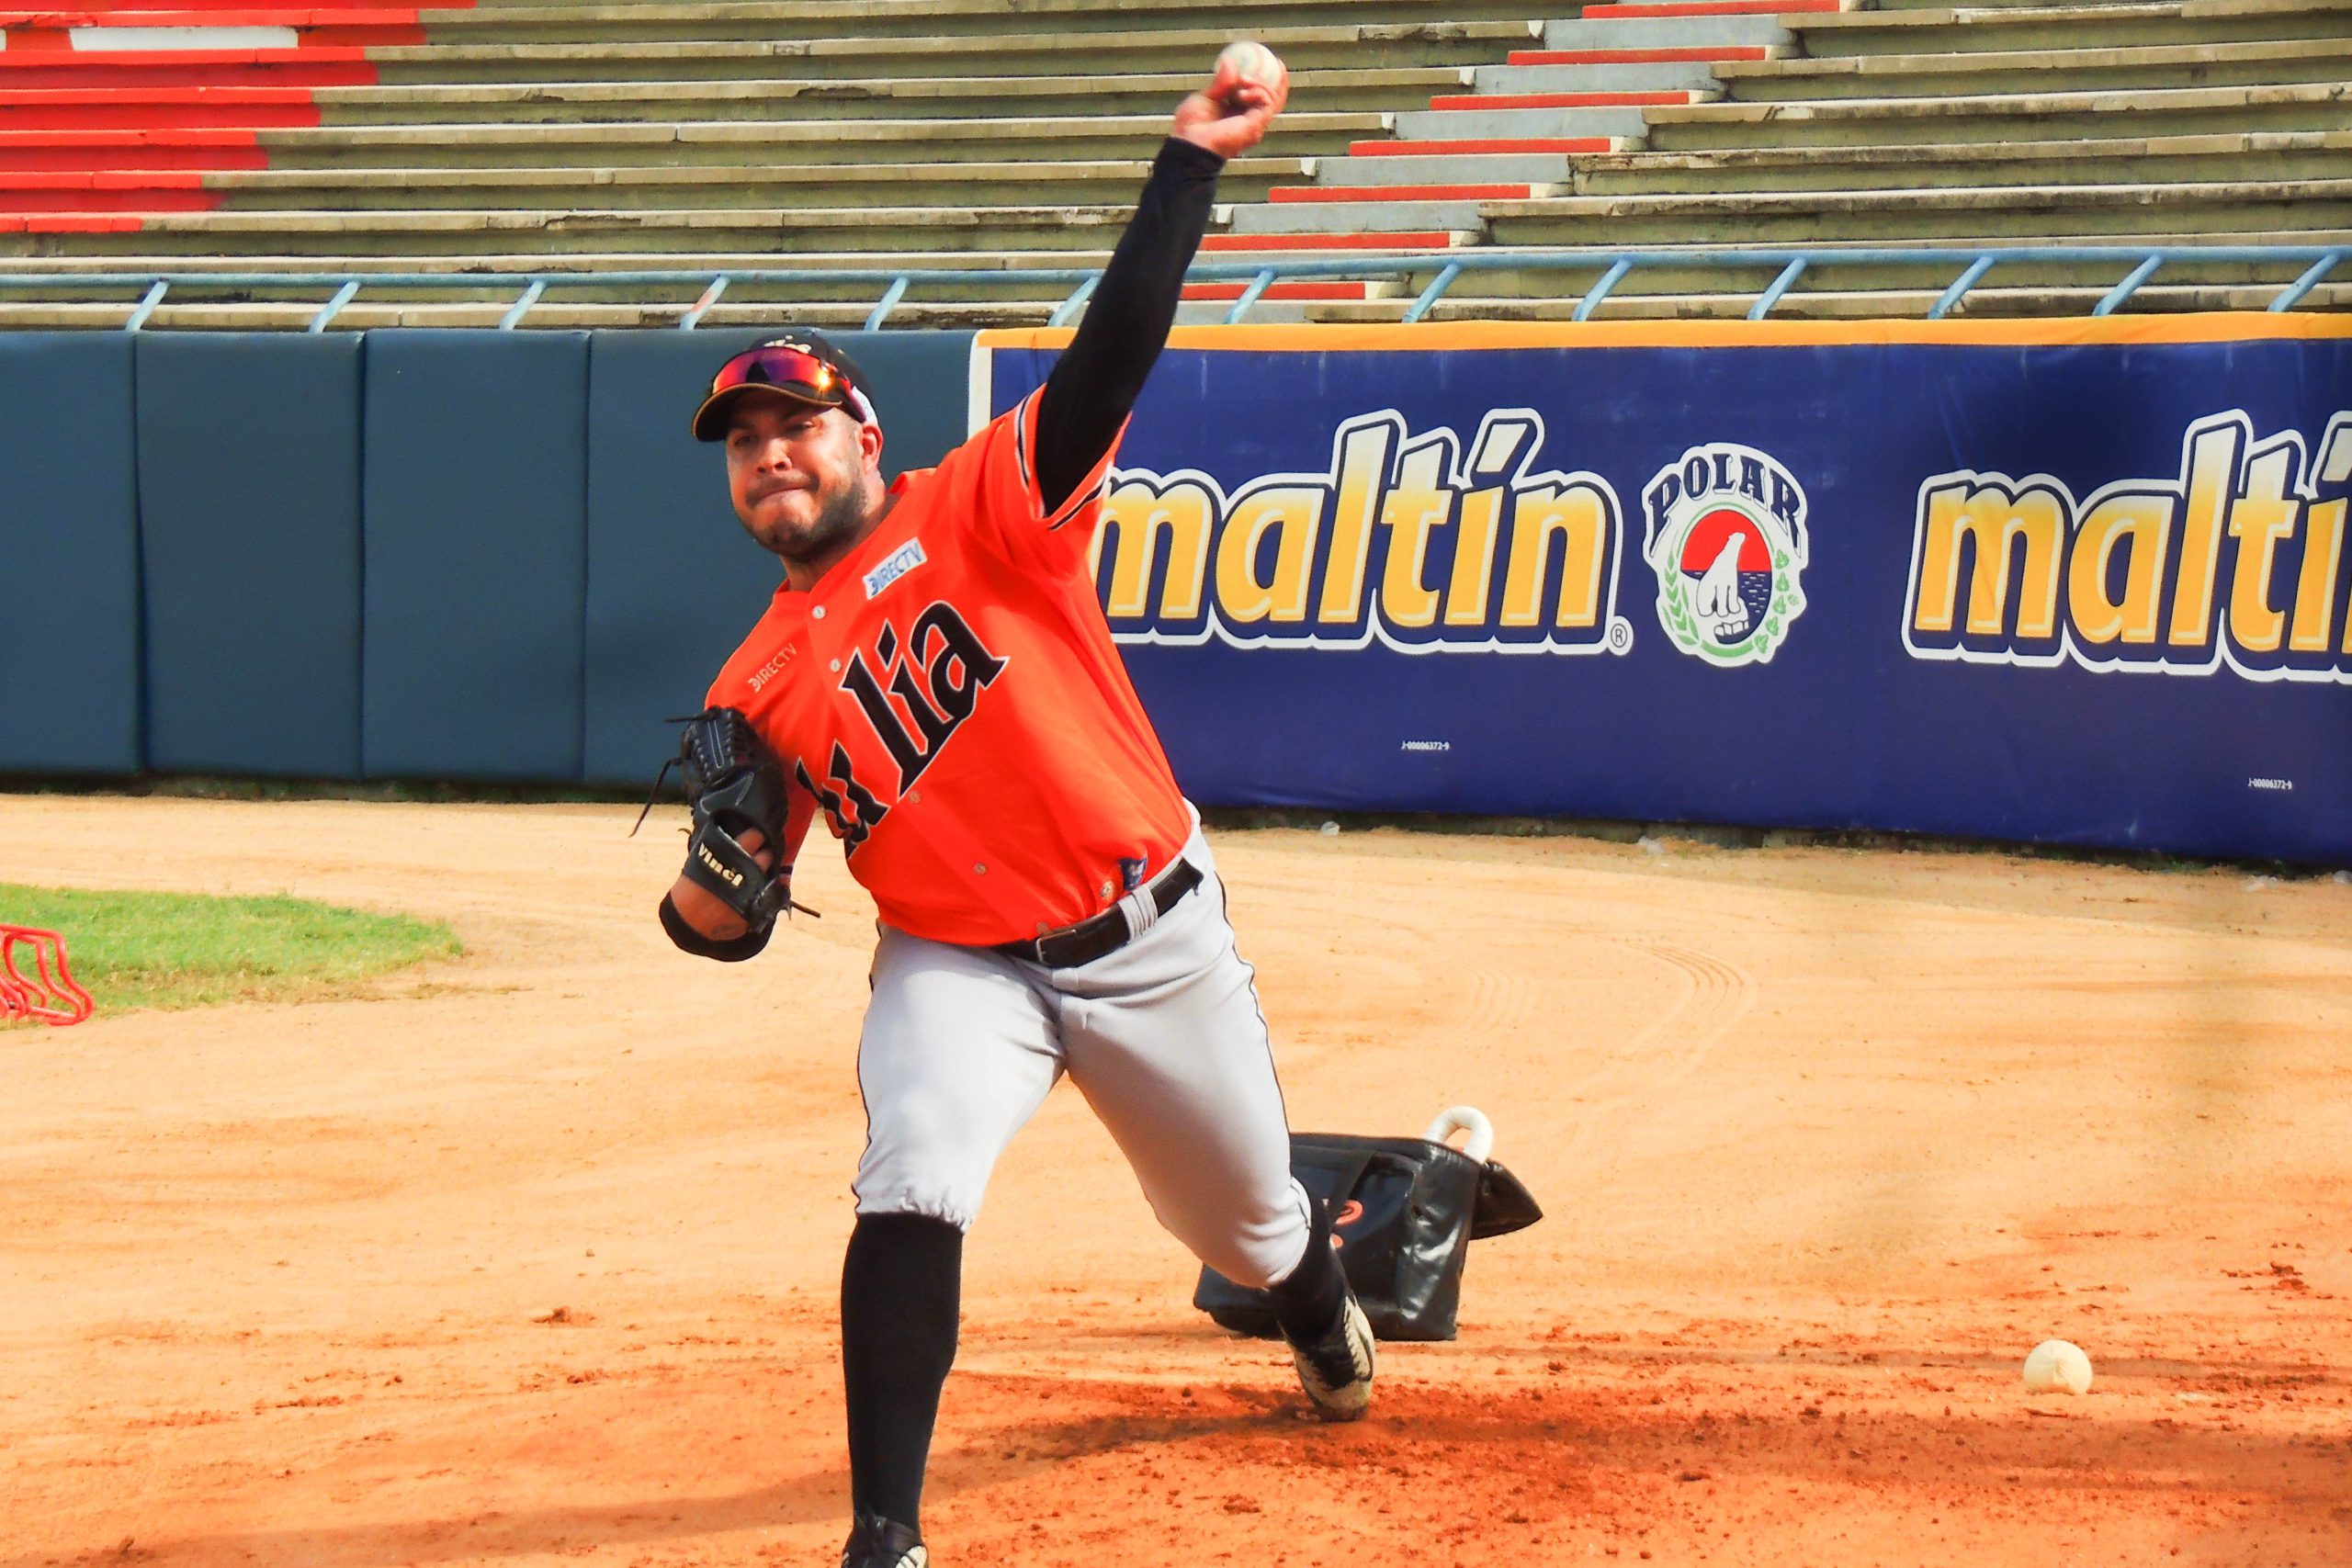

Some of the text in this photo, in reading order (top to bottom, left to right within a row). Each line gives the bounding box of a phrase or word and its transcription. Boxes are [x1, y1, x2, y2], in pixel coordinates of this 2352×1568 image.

[867, 542, 922, 597] DIRECTV
[1087, 418, 1608, 628] maltín
[1648, 452, 1802, 558] POLAR
[1914, 423, 2352, 654] maltí
[747, 641, 798, 694] DIRECTV
[796, 600, 1011, 860] ulia
